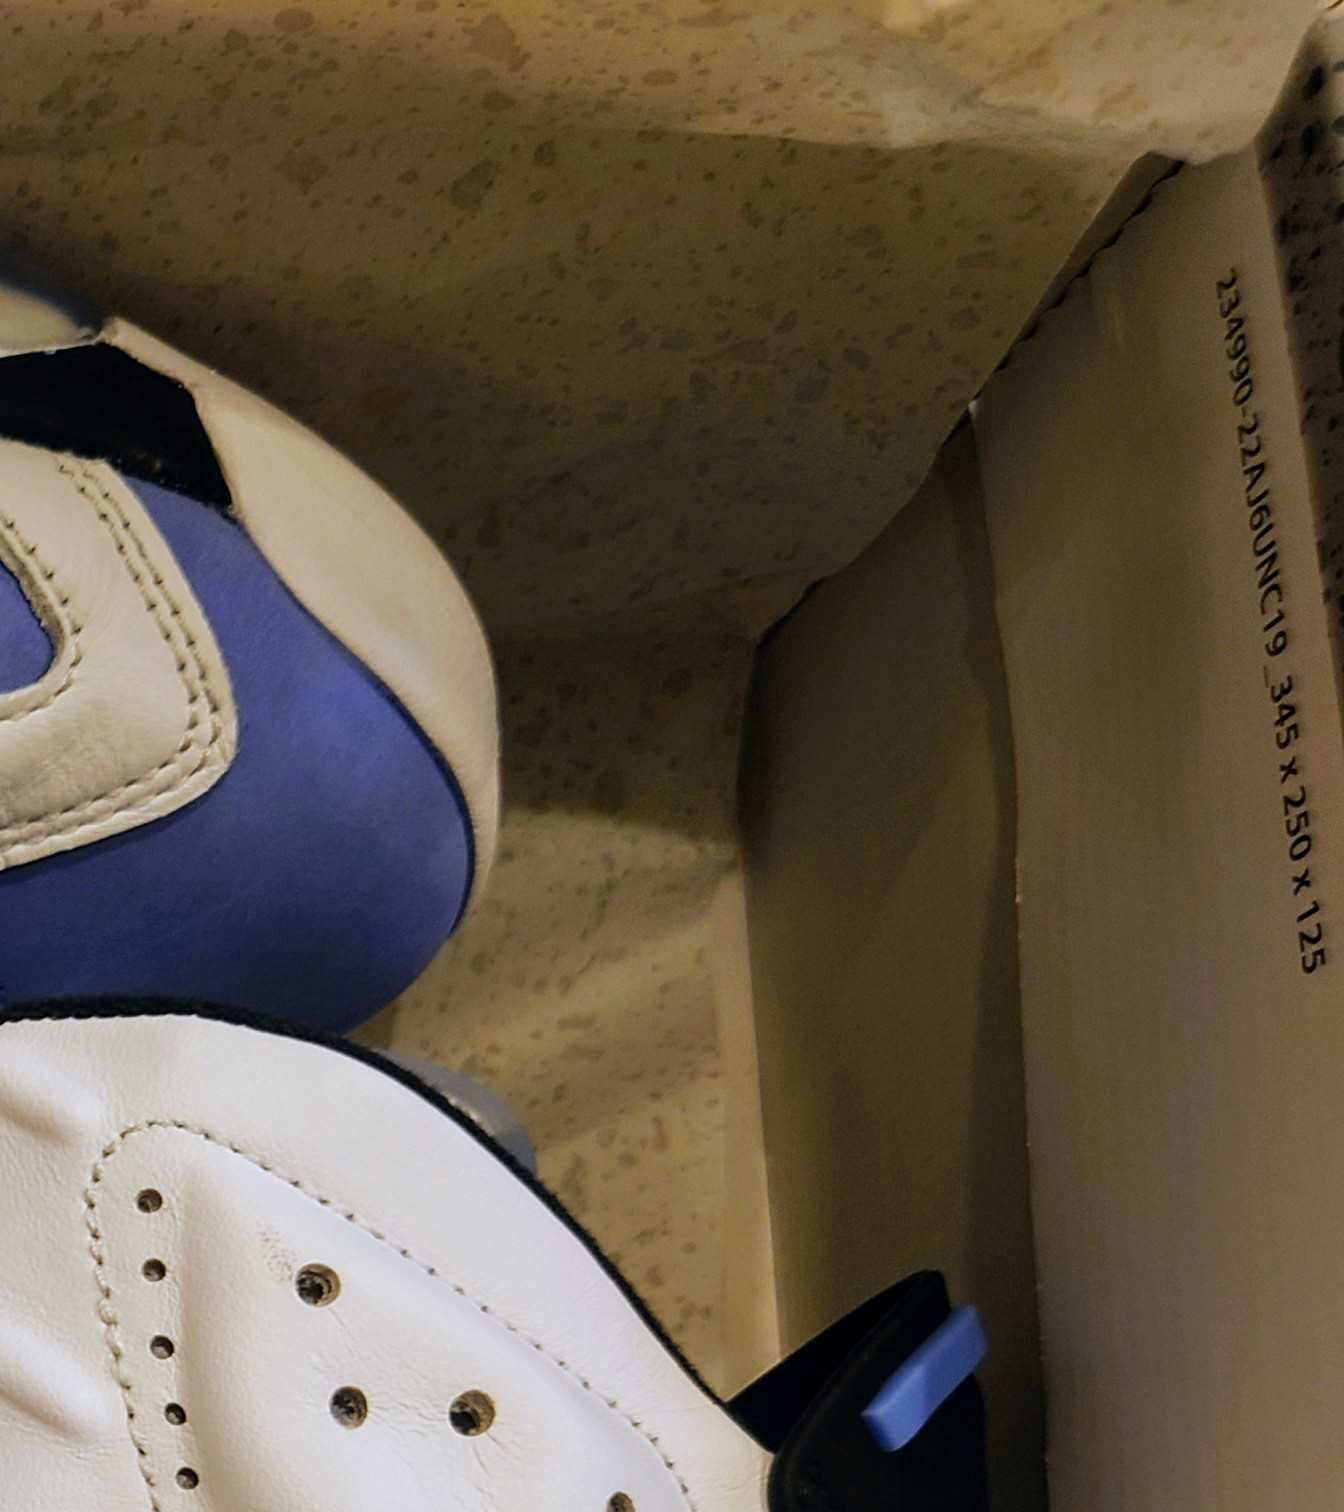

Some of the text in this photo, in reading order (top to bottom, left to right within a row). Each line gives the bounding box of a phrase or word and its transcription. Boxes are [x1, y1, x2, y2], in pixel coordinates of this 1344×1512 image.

[1216, 267, 1287, 657] 234990-22AJ6UNC19
[1279, 756, 1298, 784] x
[1283, 785, 1312, 861] 250
[1292, 868, 1311, 896] x
[1297, 900, 1326, 974] 125
